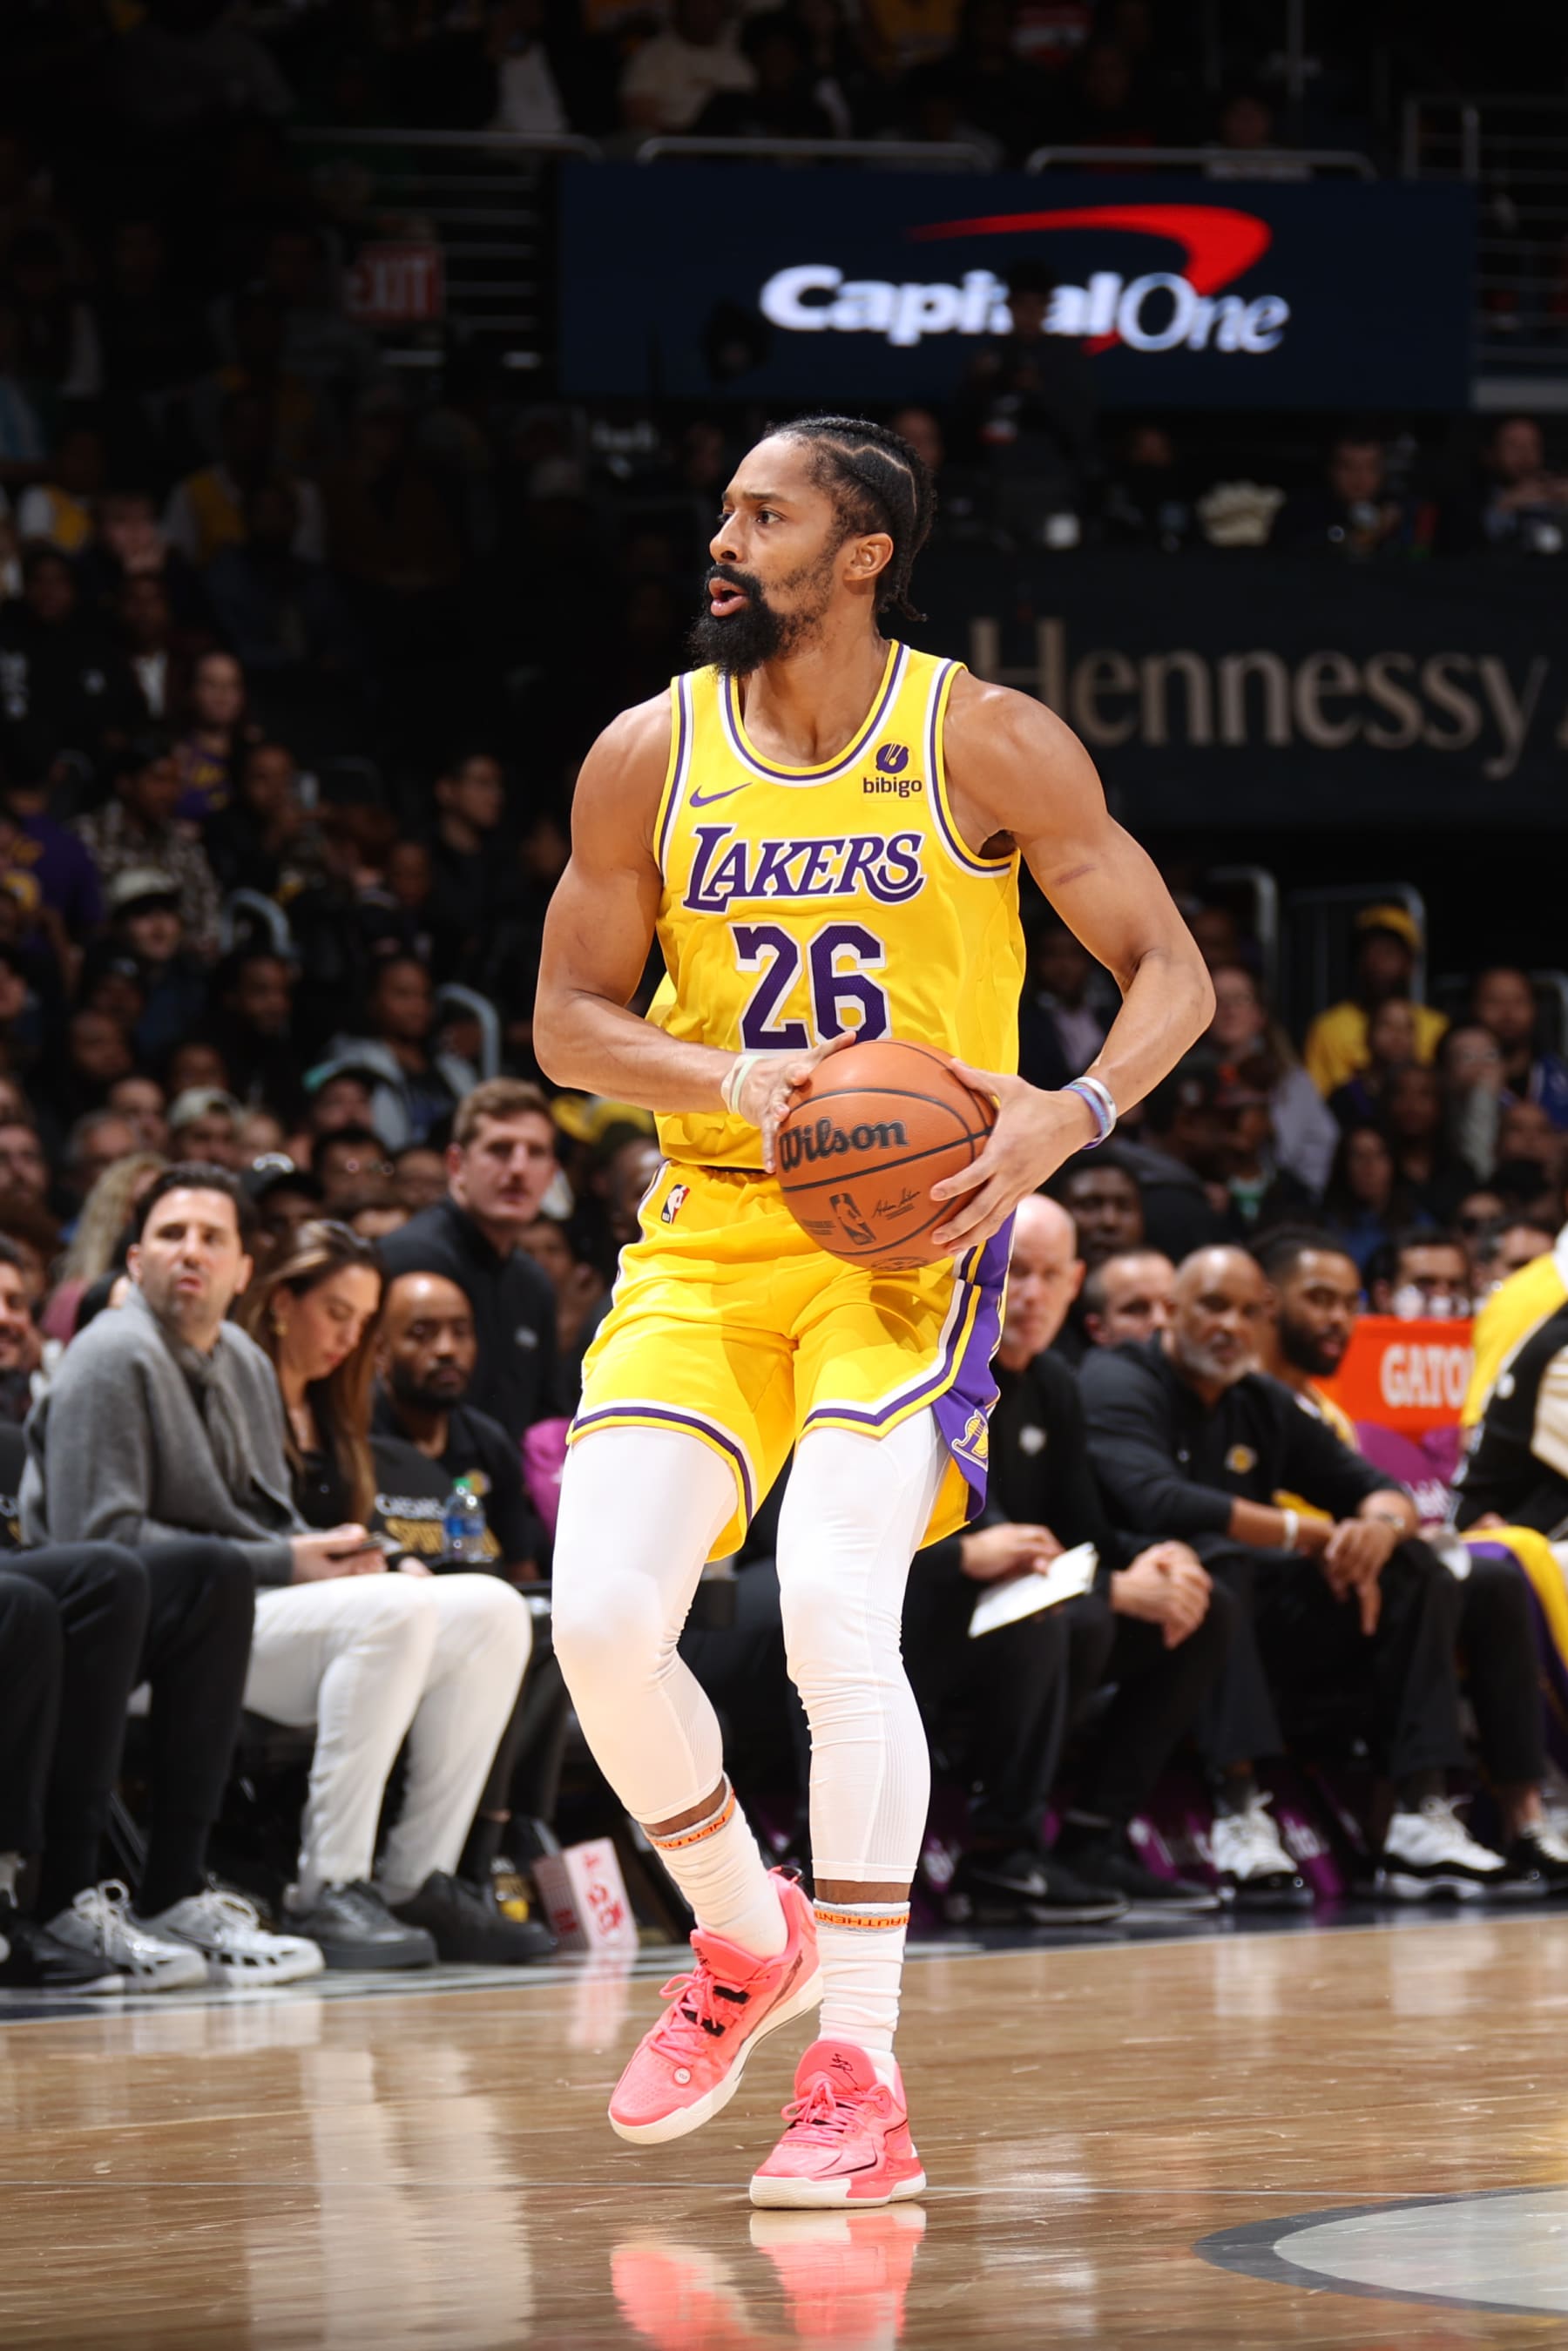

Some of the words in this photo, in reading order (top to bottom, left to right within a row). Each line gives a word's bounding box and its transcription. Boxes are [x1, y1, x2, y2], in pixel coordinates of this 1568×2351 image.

[970, 617, 1549, 779] Hennessy
[862, 776, 923, 799] bibigo
[682, 823, 928, 915] LAKERS
[727, 921, 893, 1054] 26
[779, 1116, 909, 1172] Wilson
